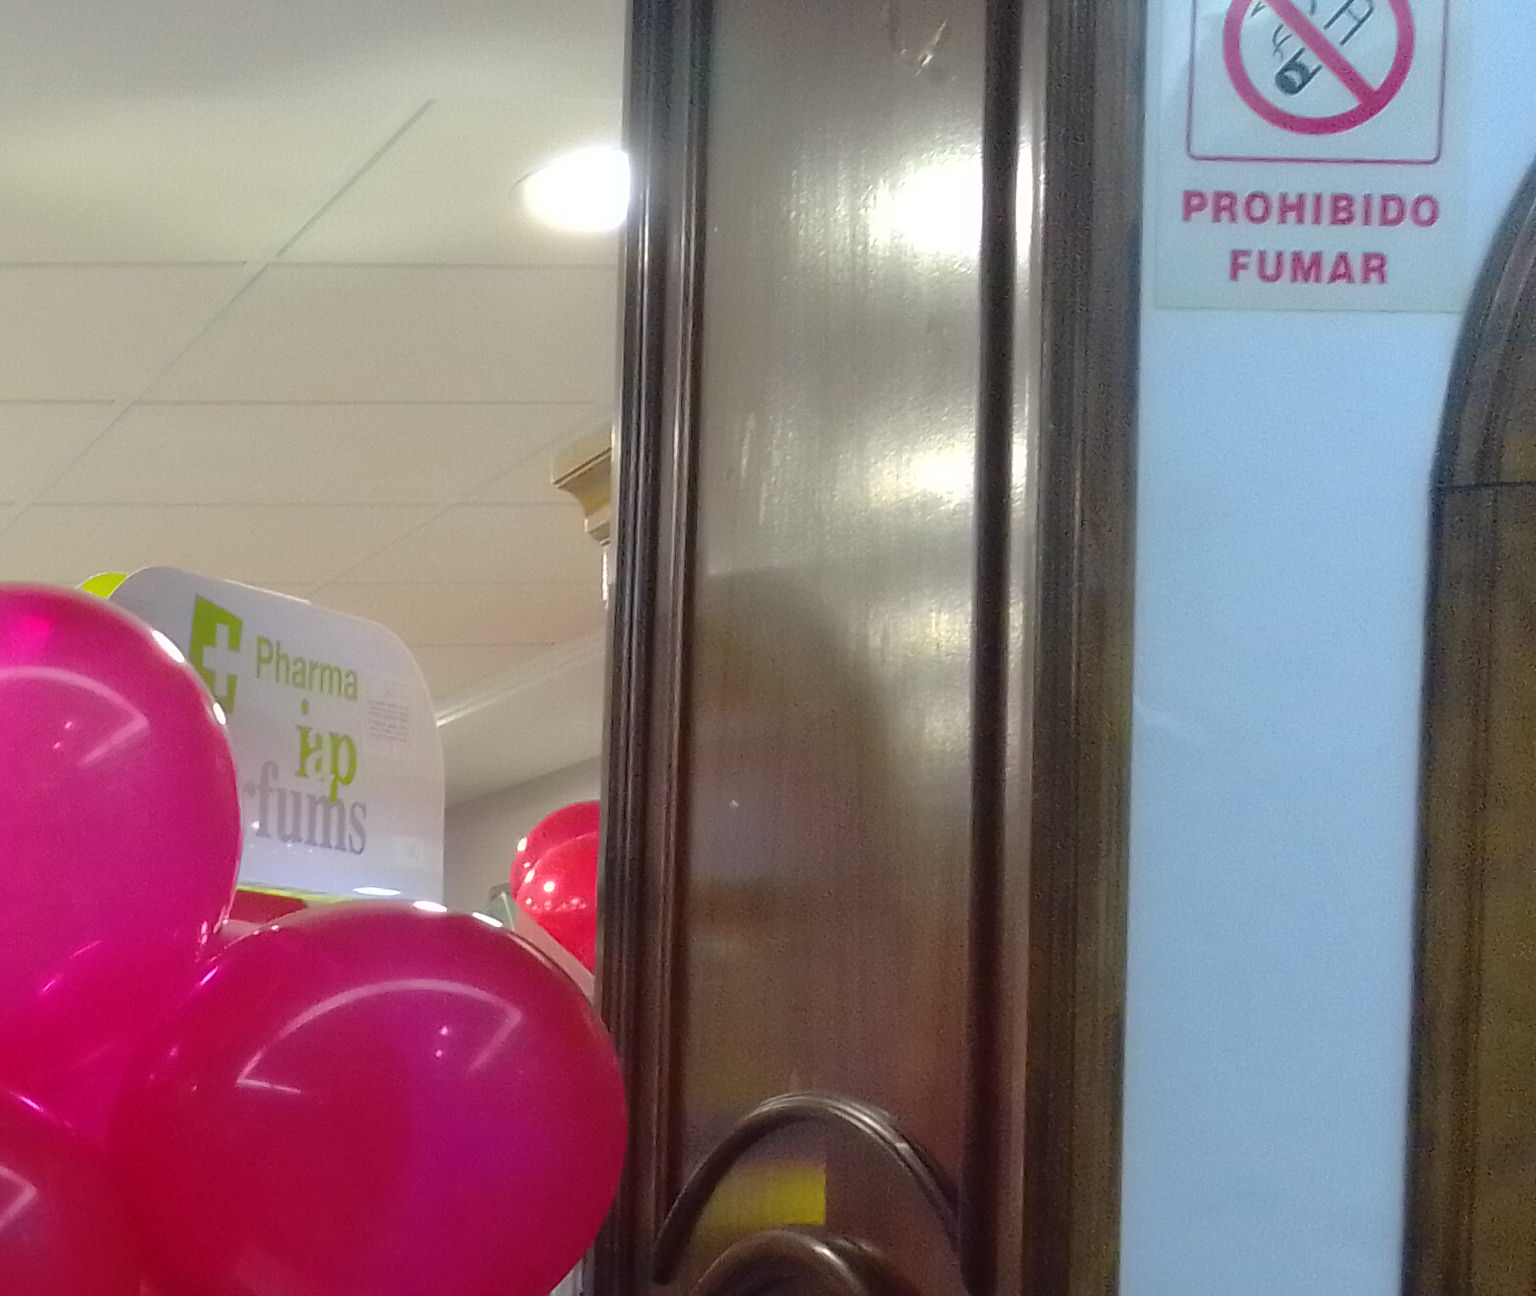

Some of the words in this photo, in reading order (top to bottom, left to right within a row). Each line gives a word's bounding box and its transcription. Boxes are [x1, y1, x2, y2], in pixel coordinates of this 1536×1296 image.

[1181, 190, 1440, 228] PROHIBIDO
[1229, 249, 1388, 285] FUMAR
[256, 636, 358, 701] Pharma
[244, 760, 368, 856] fums
